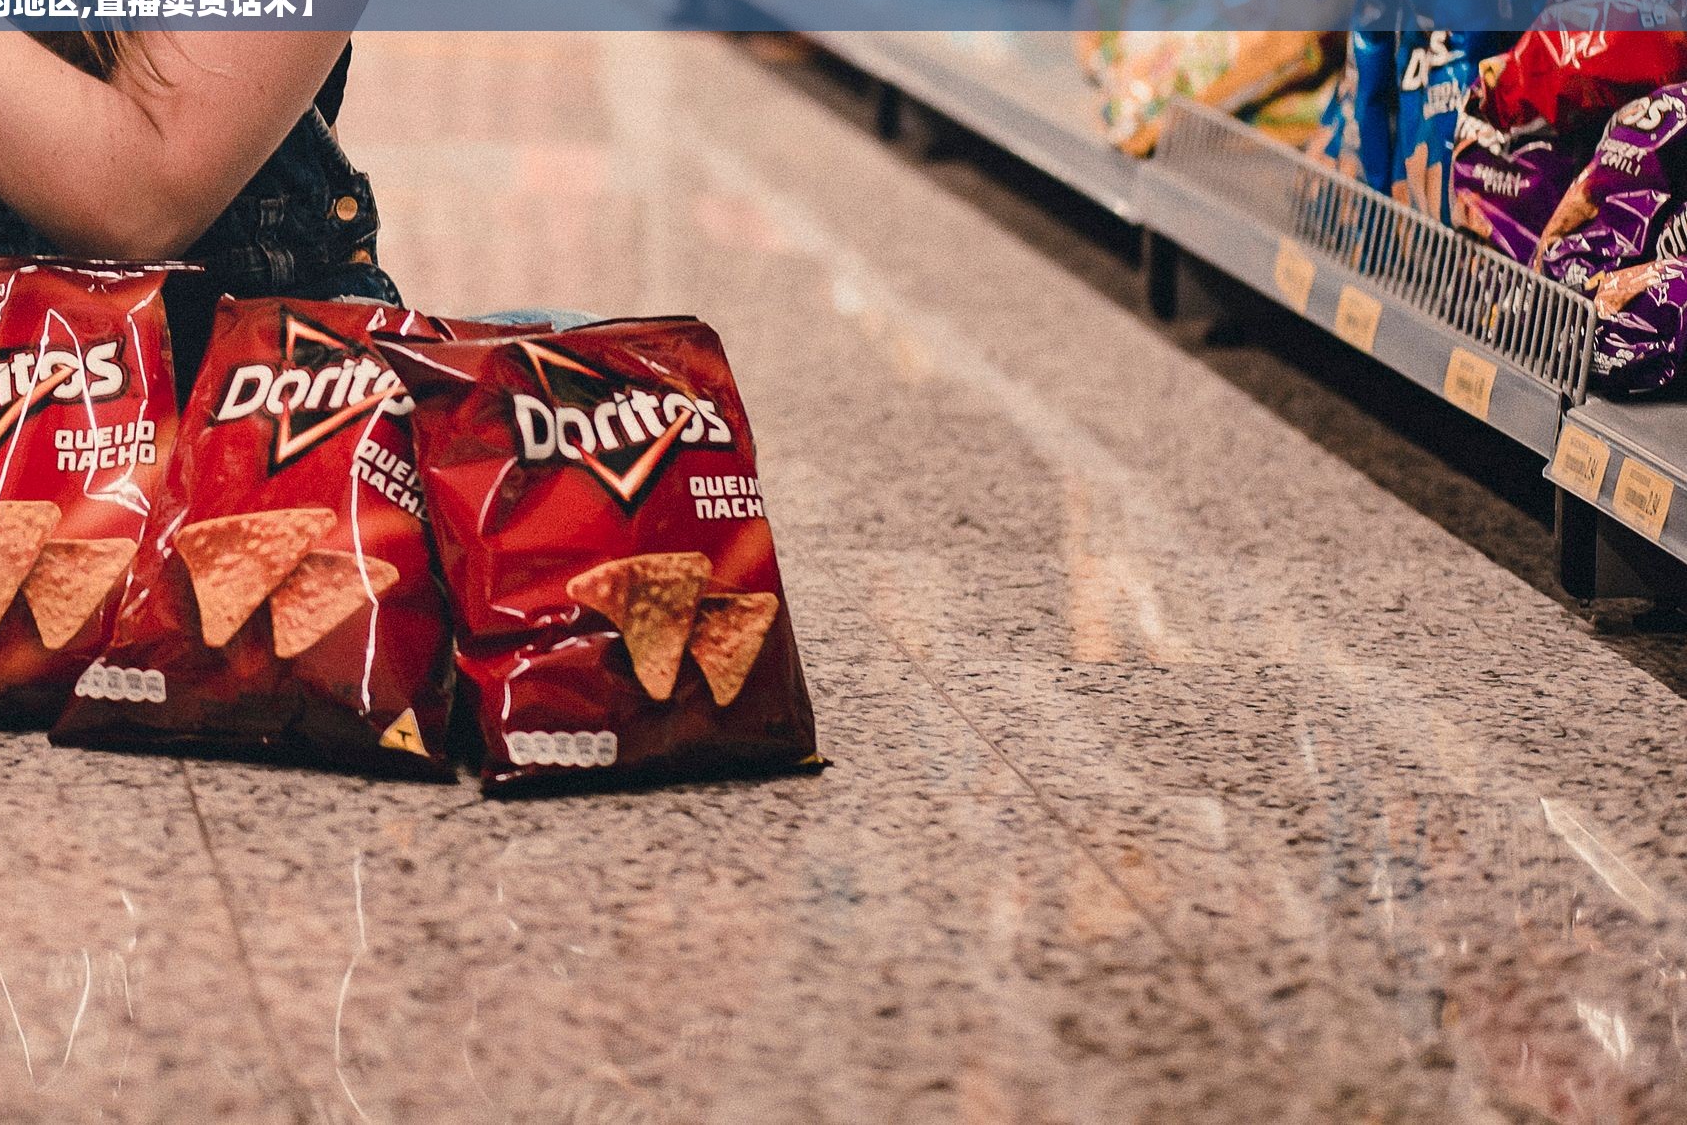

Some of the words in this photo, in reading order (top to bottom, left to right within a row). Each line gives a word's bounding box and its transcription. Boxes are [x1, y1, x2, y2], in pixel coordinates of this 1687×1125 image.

[216, 357, 417, 422] Dorito
[53, 419, 156, 451] QUEIJO
[512, 388, 733, 461] Doritos
[57, 442, 157, 472] NACHO
[354, 437, 419, 488] QUEI
[688, 475, 761, 497] QUEIJ
[695, 497, 765, 520] NACH
